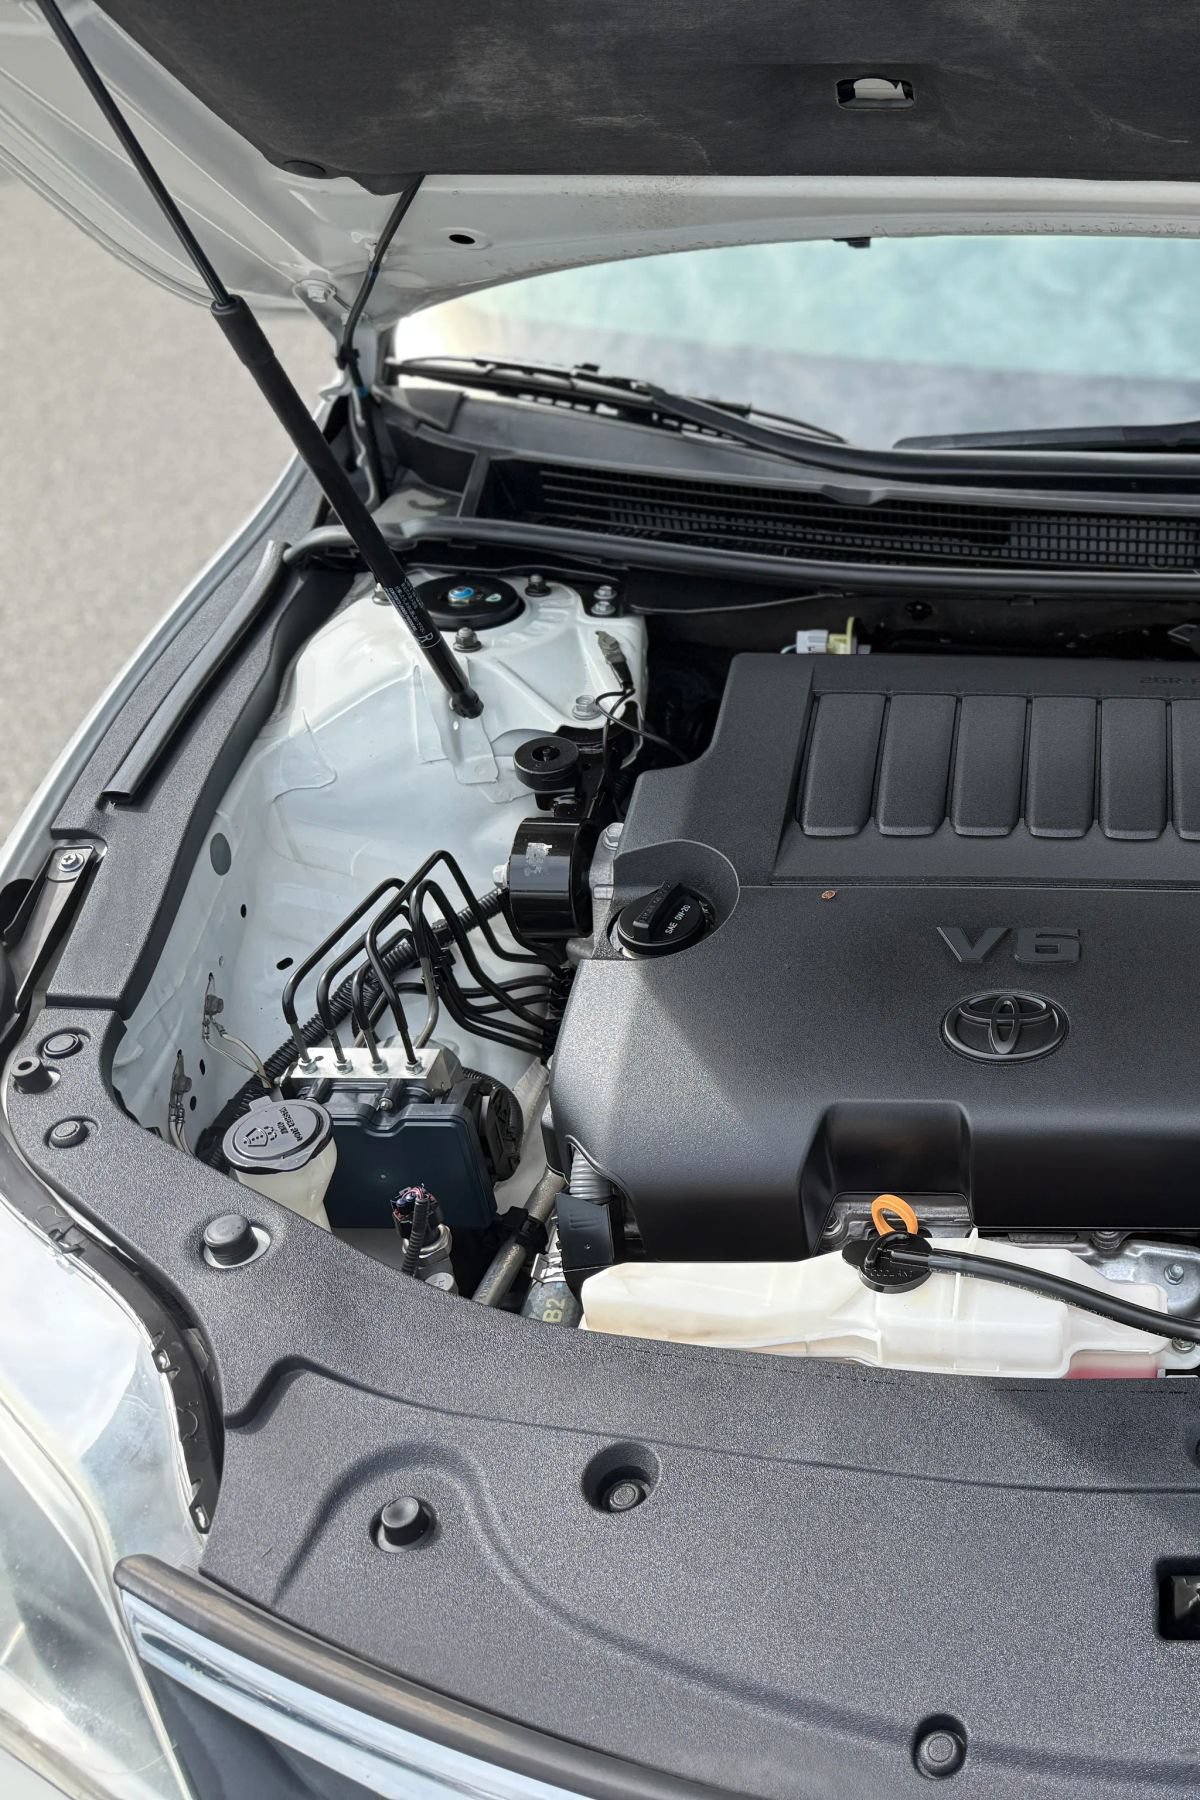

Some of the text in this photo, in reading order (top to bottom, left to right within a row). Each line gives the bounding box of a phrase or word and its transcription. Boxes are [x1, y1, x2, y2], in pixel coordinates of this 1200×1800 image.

[665, 922, 678, 934] SAE
[936, 926, 1081, 964] V6
[542, 1297, 566, 1323] B2
